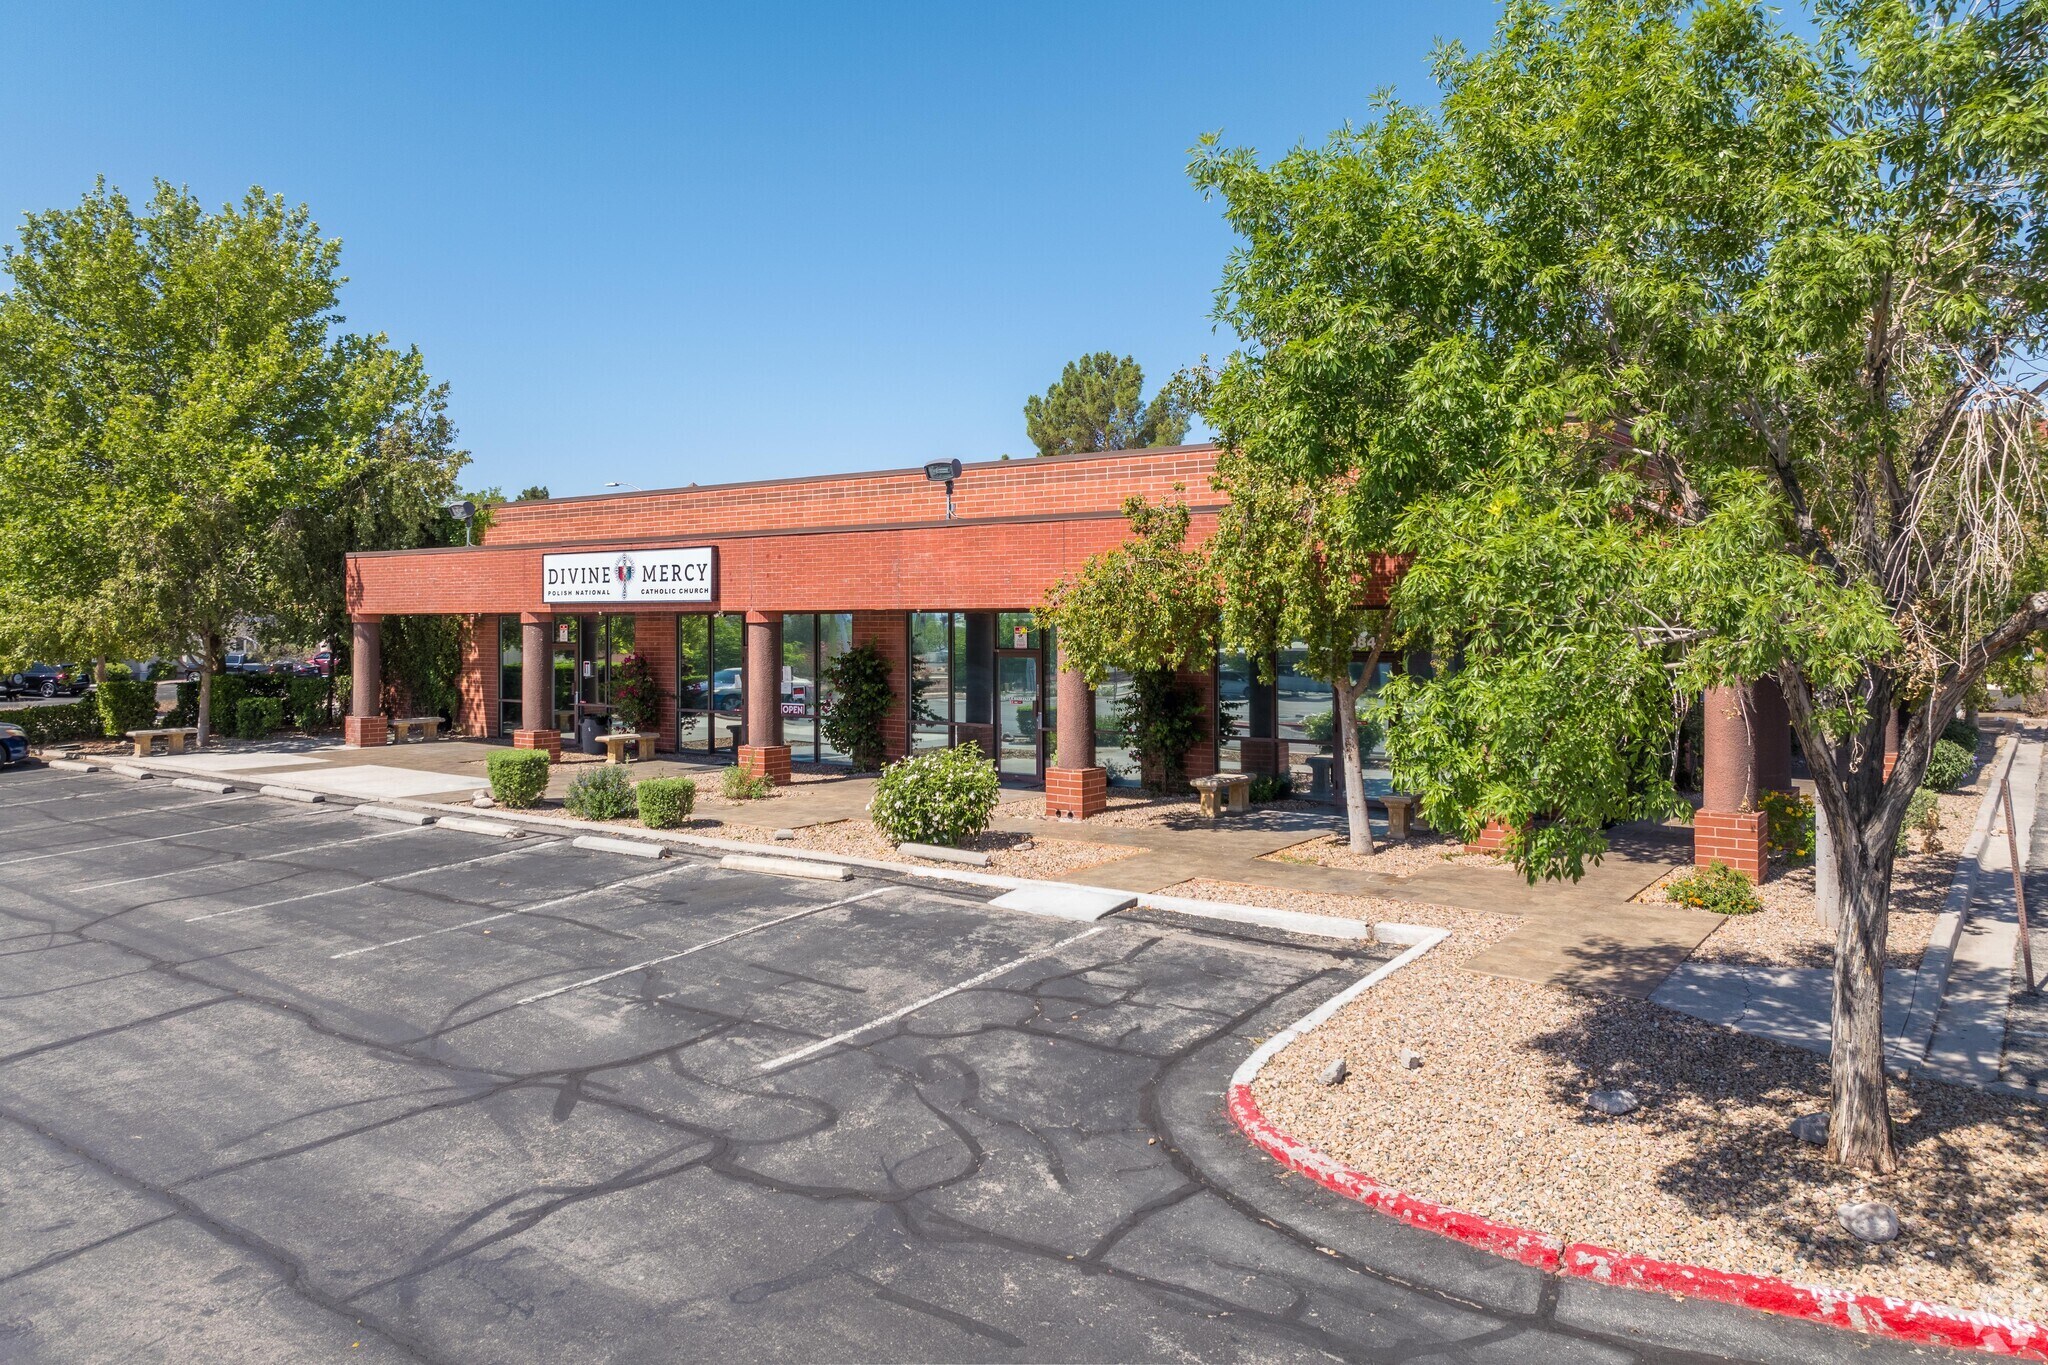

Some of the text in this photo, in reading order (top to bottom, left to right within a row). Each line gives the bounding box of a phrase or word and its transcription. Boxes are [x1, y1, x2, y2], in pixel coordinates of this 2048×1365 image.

[548, 563, 708, 585] DIVINE MERCY
[782, 705, 803, 714] OPEN
[1810, 1286, 2037, 1337] NO PARKING
